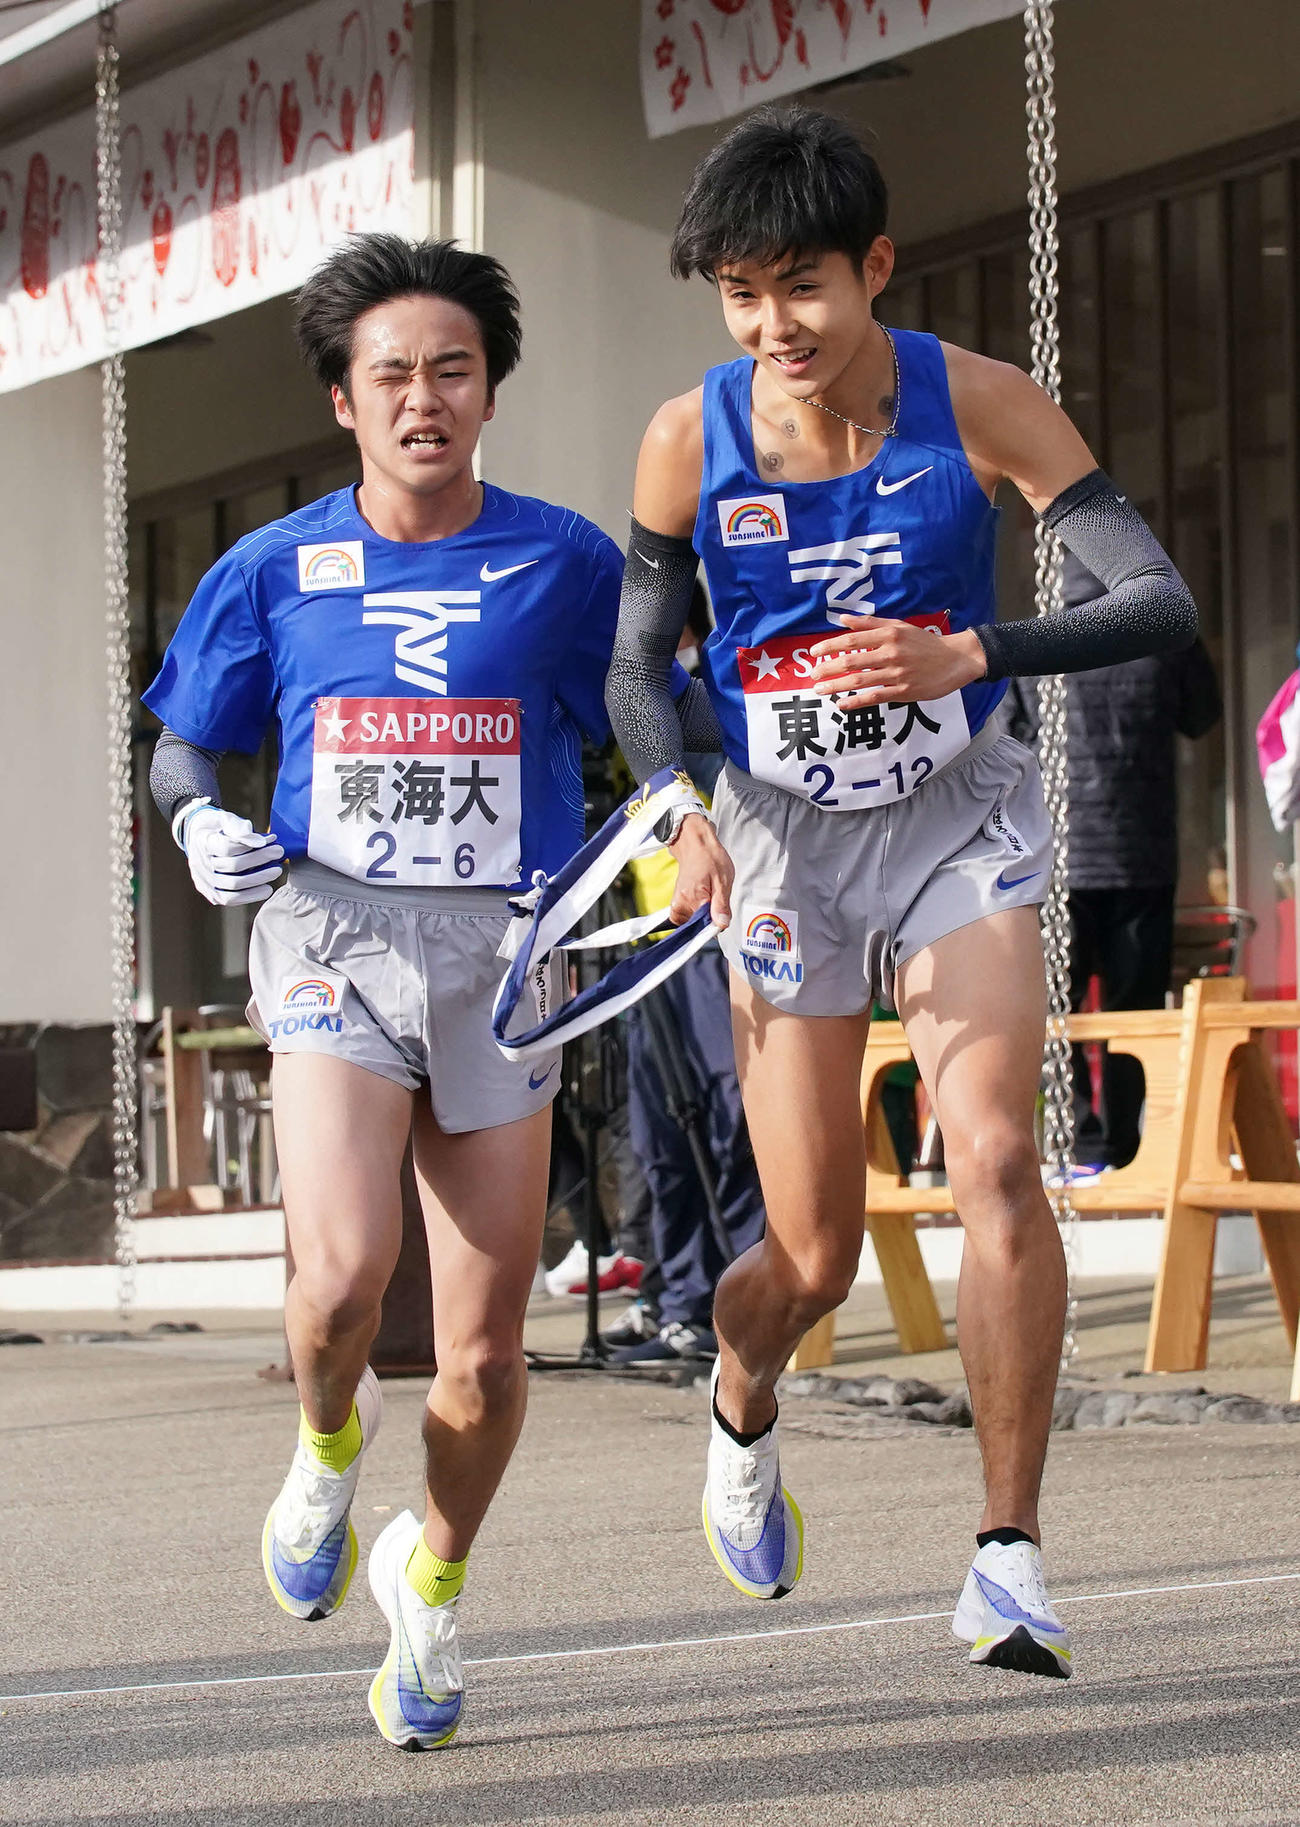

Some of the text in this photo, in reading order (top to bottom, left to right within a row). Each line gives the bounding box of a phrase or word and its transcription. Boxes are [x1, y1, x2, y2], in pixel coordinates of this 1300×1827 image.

[728, 531, 766, 541] SUNSHINE
[360, 711, 515, 743] SAPPORO
[334, 759, 499, 826] 東海大
[739, 950, 804, 983] TOKAI
[268, 1014, 344, 1039] TOKAI
